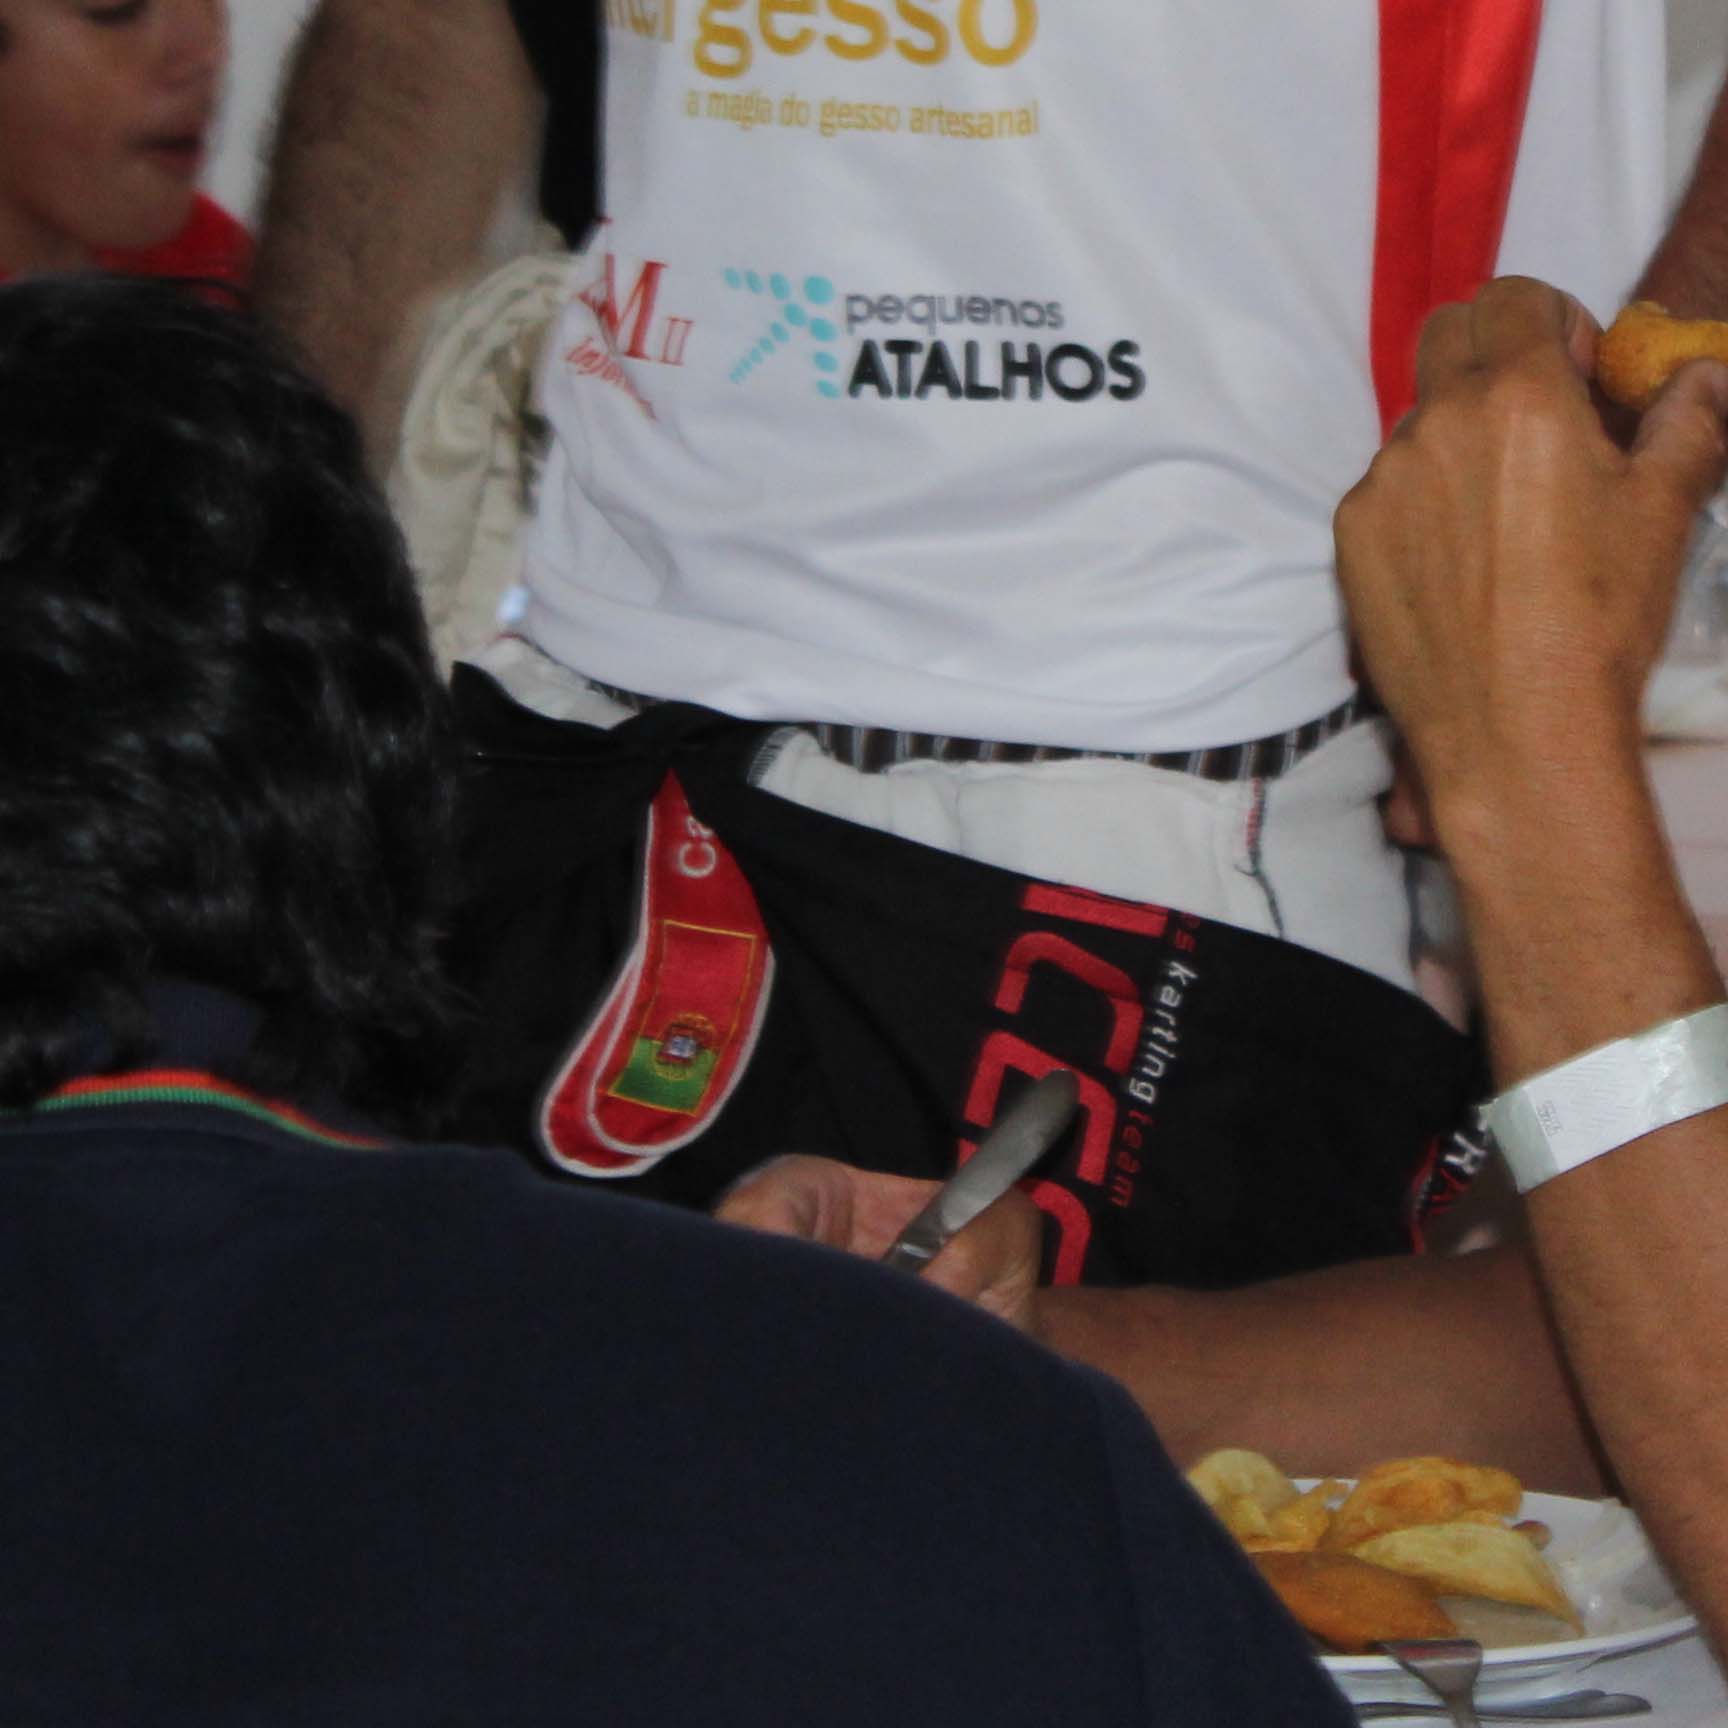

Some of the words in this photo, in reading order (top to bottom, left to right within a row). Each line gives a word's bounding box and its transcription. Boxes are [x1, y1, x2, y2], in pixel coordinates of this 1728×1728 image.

[706, 91, 773, 132] magia
[779, 93, 810, 127] do
[819, 99, 901, 137] gesso
[908, 99, 1039, 139] artesanal
[844, 294, 1065, 335] pequenos
[847, 339, 1147, 403] ATALHOS
[1127, 958, 1199, 1105] karting
[1108, 1109, 1154, 1209] team
